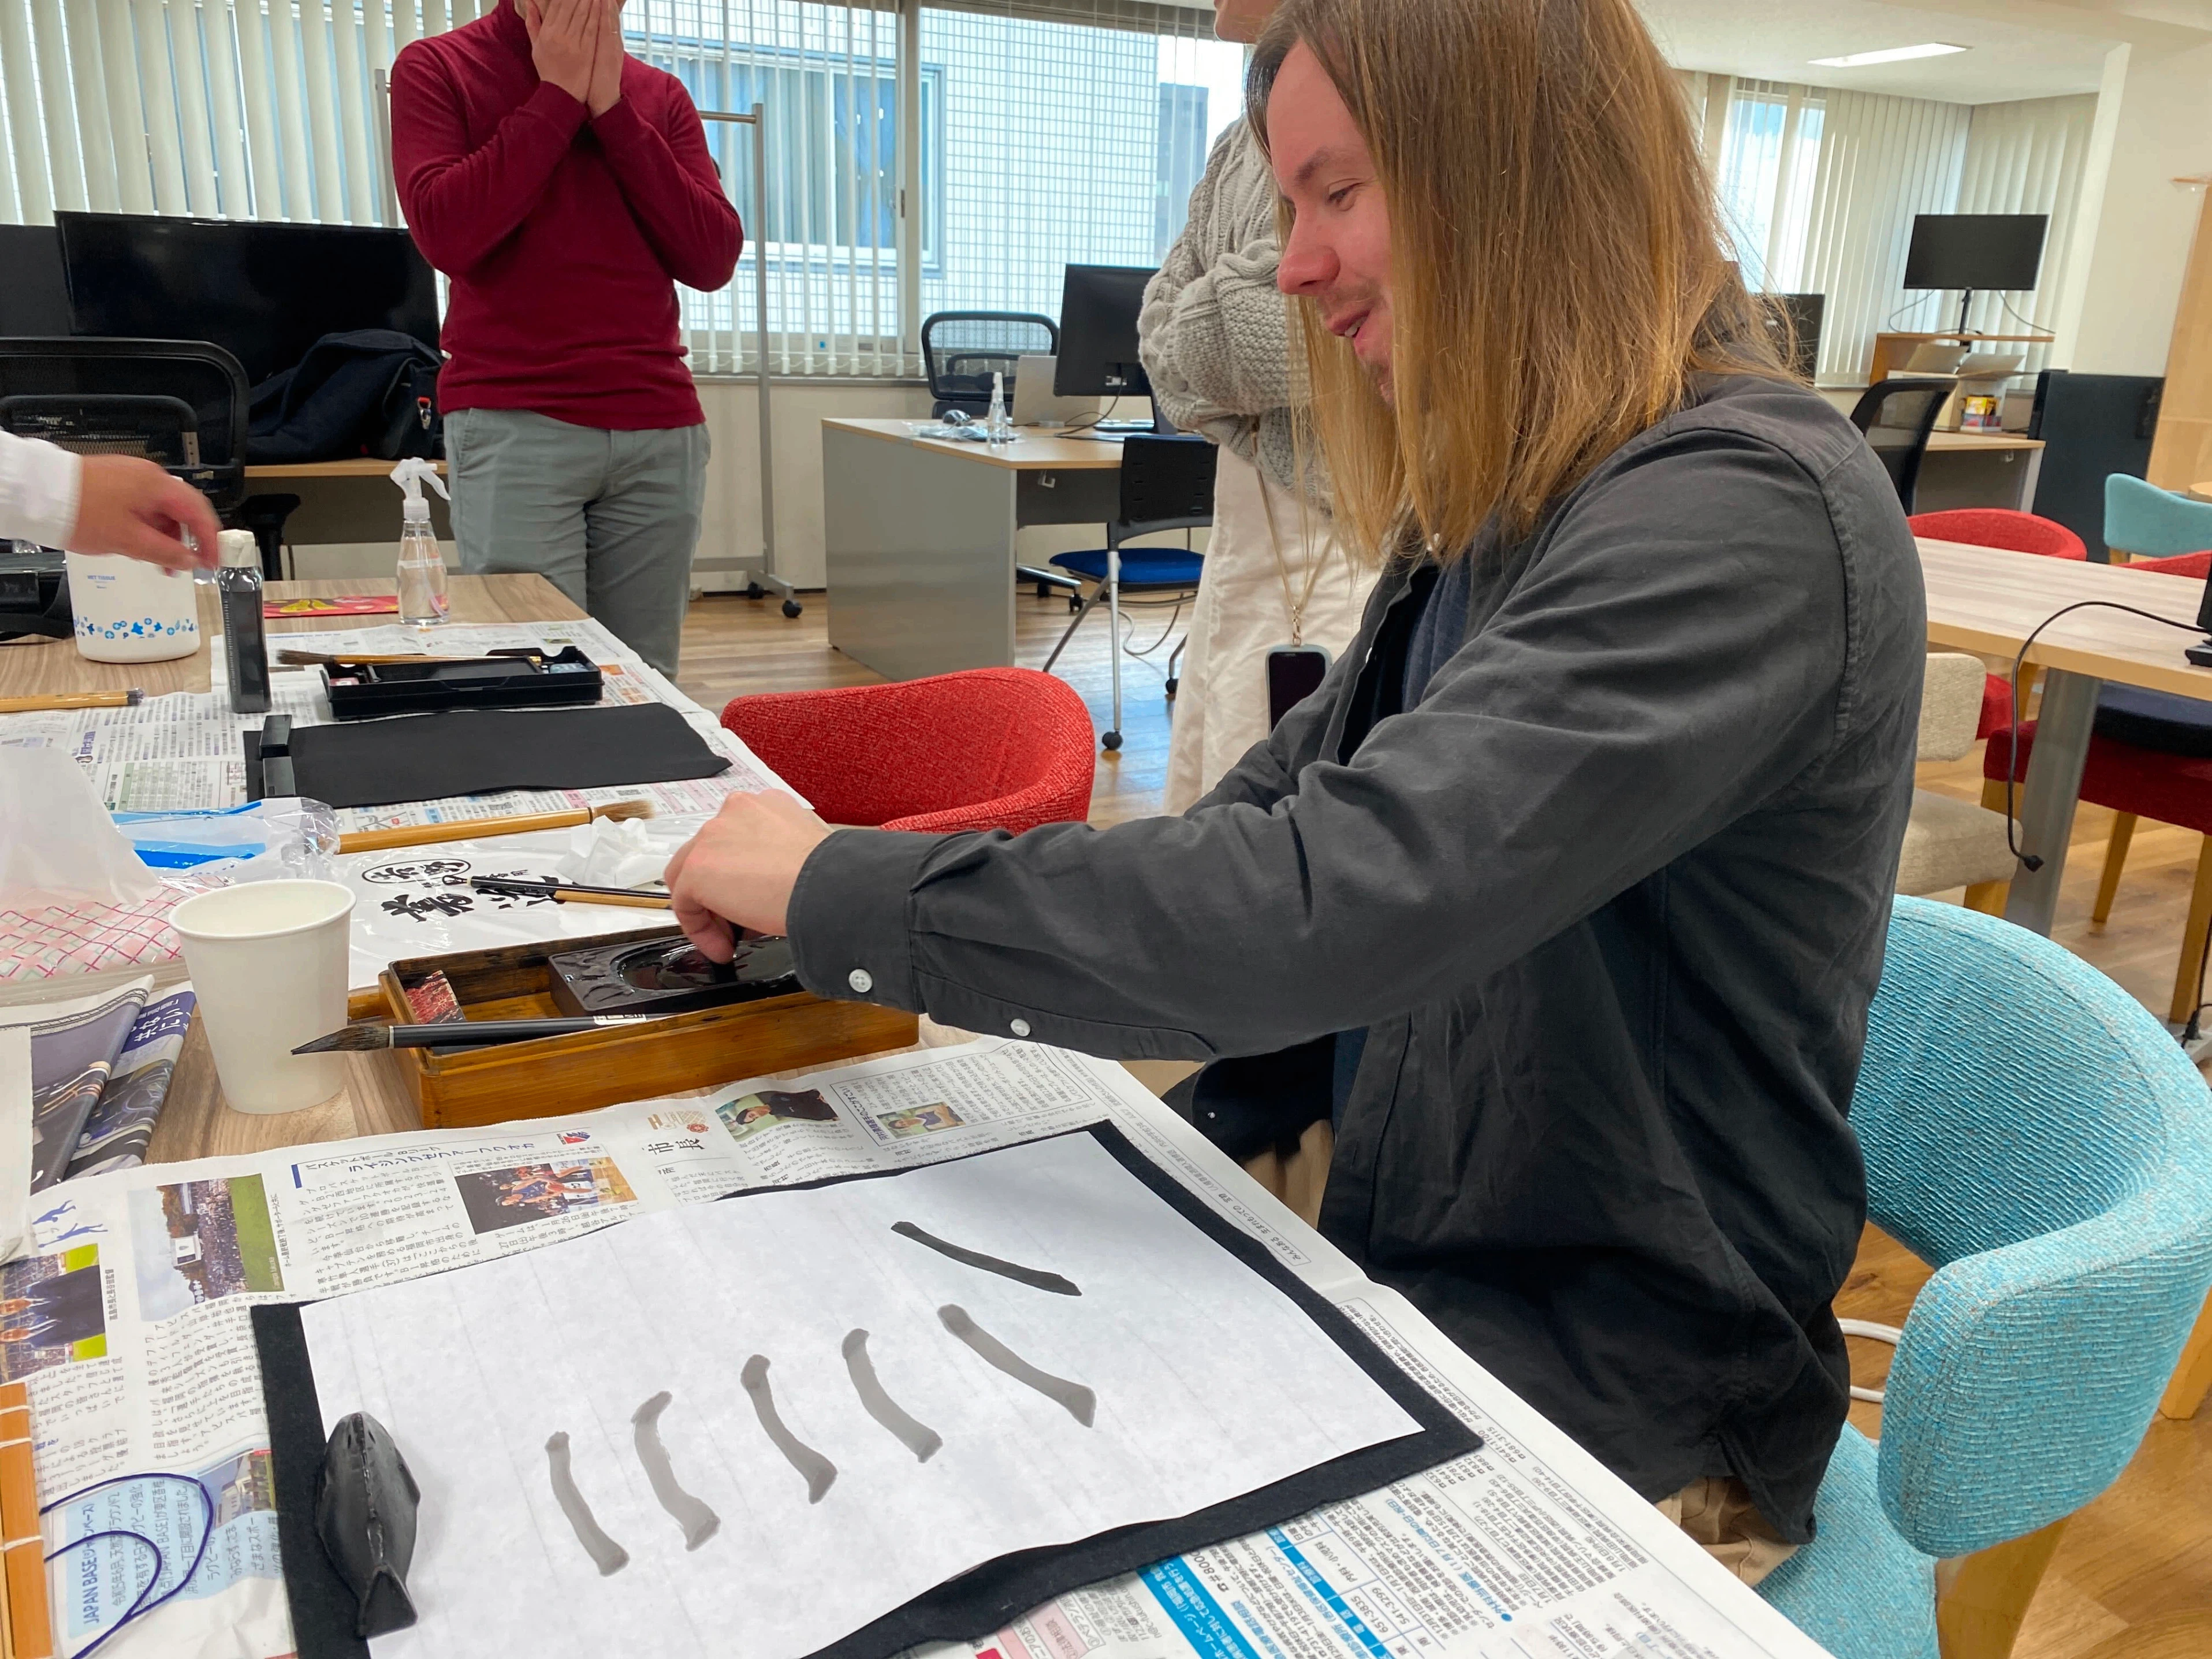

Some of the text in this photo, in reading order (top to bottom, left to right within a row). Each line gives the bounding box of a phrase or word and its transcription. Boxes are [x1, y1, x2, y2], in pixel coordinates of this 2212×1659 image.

[82, 1586, 99, 1624] JAPAN
[1349, 1594, 1390, 1634] 651-3835
[1371, 1586, 1410, 1625] 541-3299
[1394, 1645, 1410, 1656] 東
